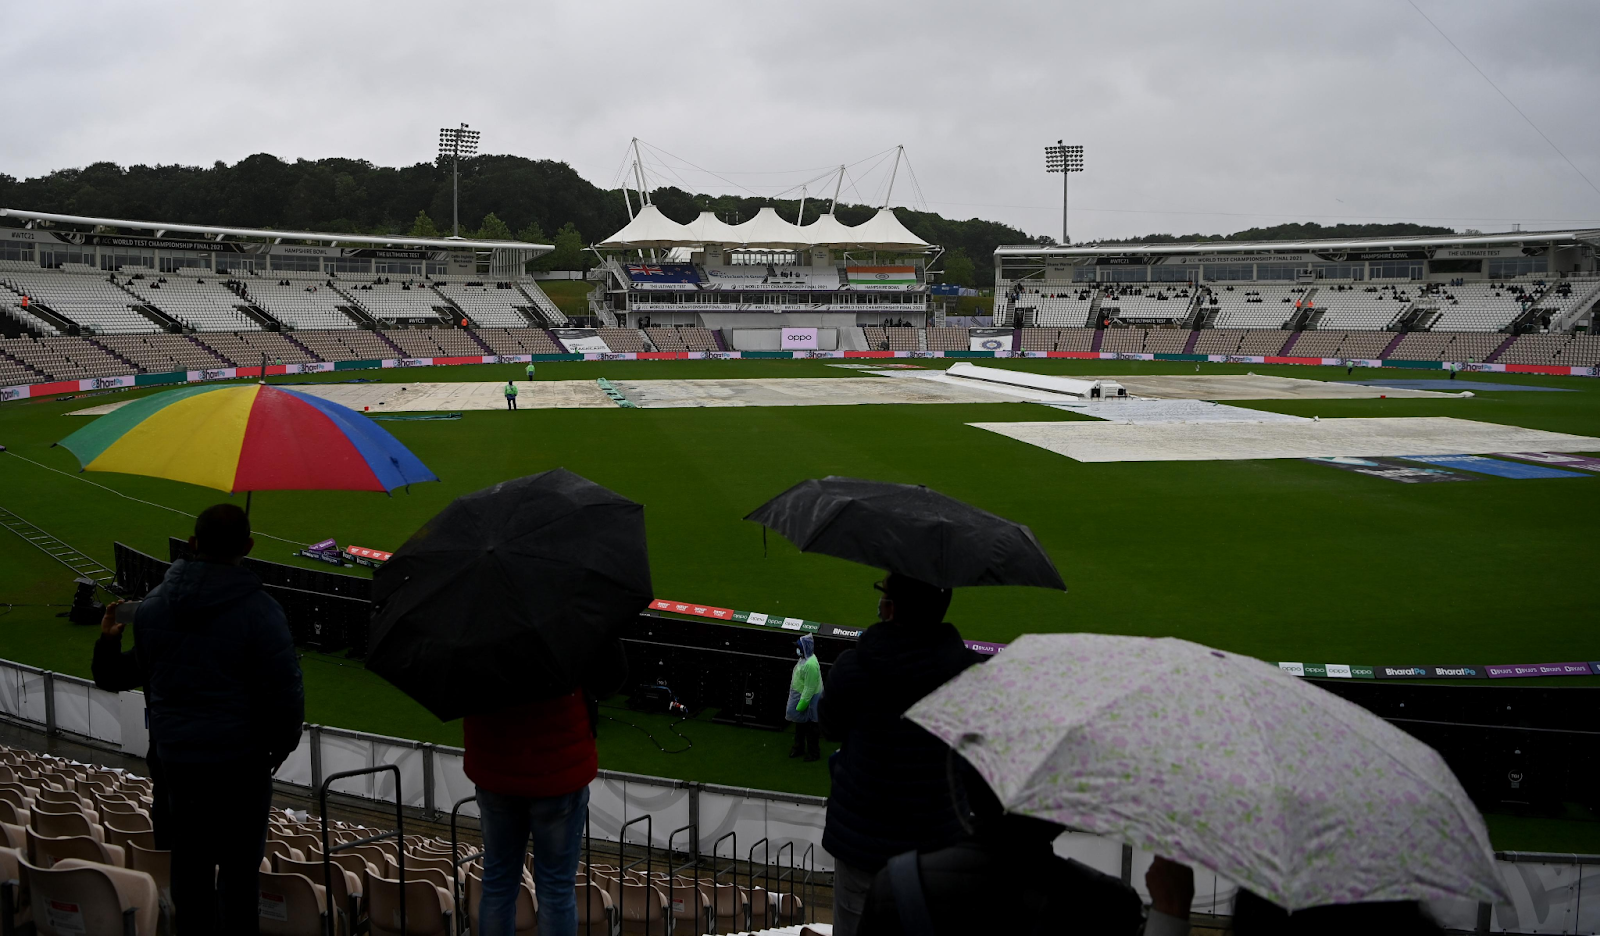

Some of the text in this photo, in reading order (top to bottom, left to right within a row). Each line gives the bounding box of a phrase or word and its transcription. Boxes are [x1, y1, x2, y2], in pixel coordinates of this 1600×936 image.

[148, 240, 193, 249] CHAMPIONSHIP
[1462, 362, 1492, 371] BharatPe
[96, 378, 123, 389] BharatPe
[833, 628, 863, 637] BharatP
